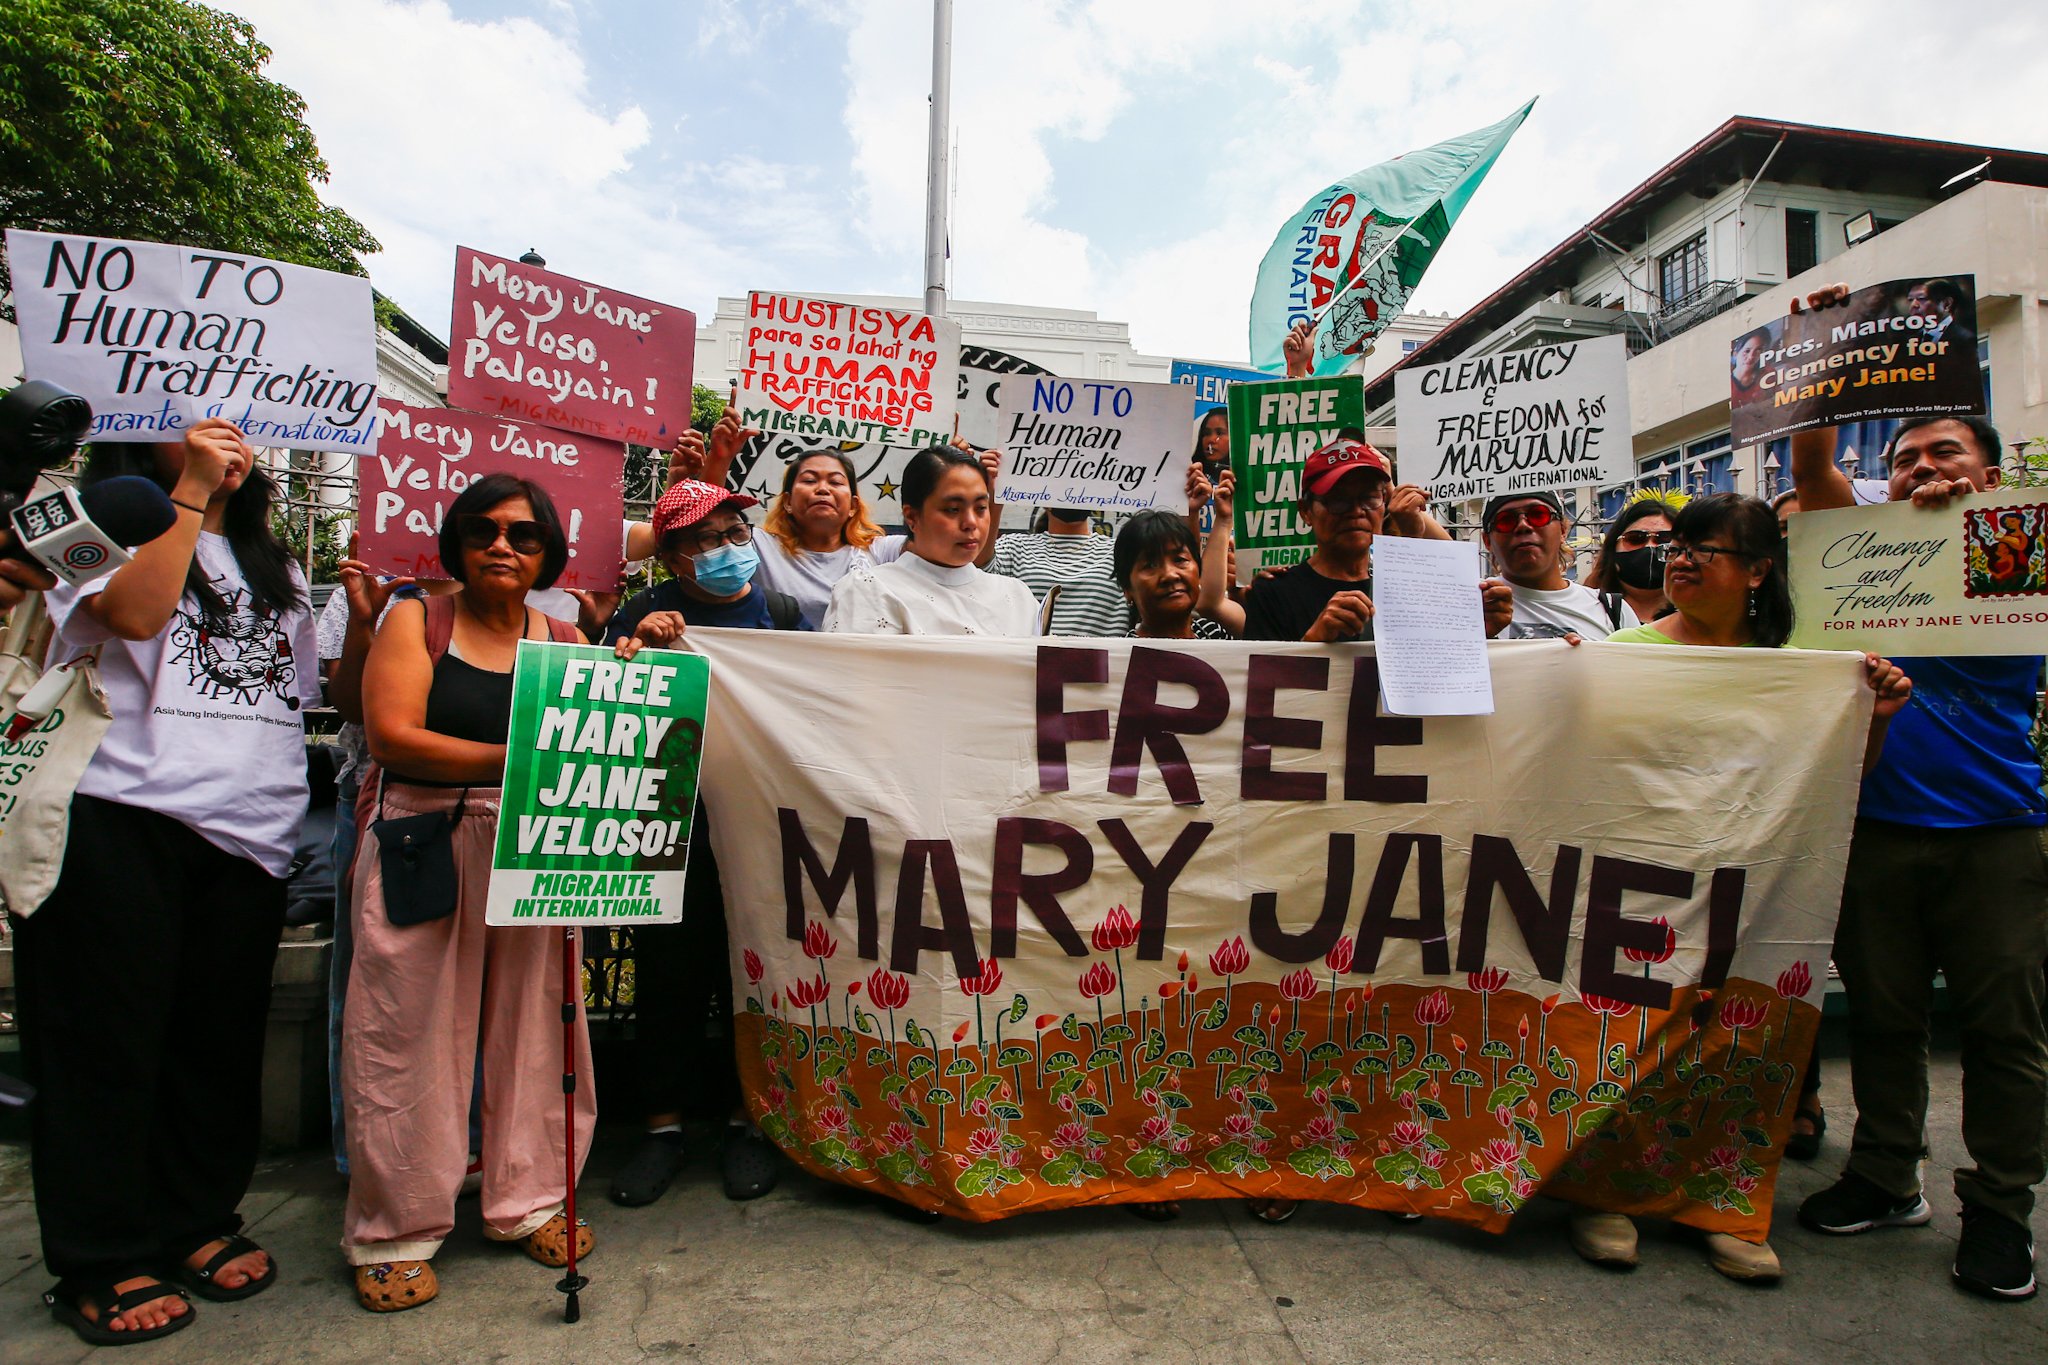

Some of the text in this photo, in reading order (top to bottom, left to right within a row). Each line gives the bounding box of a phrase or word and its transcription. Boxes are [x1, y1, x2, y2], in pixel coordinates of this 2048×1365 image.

[43, 240, 284, 306] NO TO
[471, 256, 652, 333] Mery Jane
[50, 292, 266, 357] Human
[750, 292, 936, 343] HUSTISYA
[748, 326, 938, 370] para sa lahat ng
[1758, 313, 1946, 369] Pres. Marcos,
[749, 348, 931, 392] HUMAN
[1420, 343, 1578, 396] CLEMENCY
[1758, 337, 1949, 390] Clemency for
[107, 350, 377, 427] Trafficking
[740, 369, 933, 413] TRAFFICKING
[1032, 378, 1074, 414] NO
[1083, 383, 1133, 417] TO
[1258, 388, 1340, 427] FREE
[1773, 363, 1937, 409] Mary Jane!
[769, 391, 915, 433] VICTIMS!
[1005, 412, 1122, 450] Human
[1436, 394, 1607, 447] FREEDOM for
[1740, 431, 1772, 444] Migrante
[1772, 417, 1820, 435] International
[1833, 411, 1863, 421] Church
[1863, 408, 1882, 416] Task
[1883, 406, 1904, 415] Force
[1934, 404, 1952, 413] Mary
[377, 405, 579, 466] Mery Jane
[1327, 451, 1360, 465] BOY
[42, 497, 69, 527] ABS
[1057, 486, 1157, 508] International
[23, 505, 51, 537] CBN
[1821, 530, 1948, 569] Clemency
[1857, 555, 1917, 588] and
[1824, 581, 1936, 617] Freedom
[1823, 612, 2048, 631] FOR MARY JANE VELOSO
[559, 658, 678, 707] FREE
[153, 706, 175, 715] Asia
[176, 708, 201, 720] Young
[203, 710, 254, 722] Indigenous
[535, 706, 674, 759] MARY
[1036, 645, 1429, 805] FREE
[537, 762, 668, 811] JANE
[516, 814, 682, 858] VELOSO!
[530, 872, 656, 898] MIGRANTE
[512, 898, 664, 919] INTERNATIONAL
[776, 807, 1747, 1028] MARY JANE!
